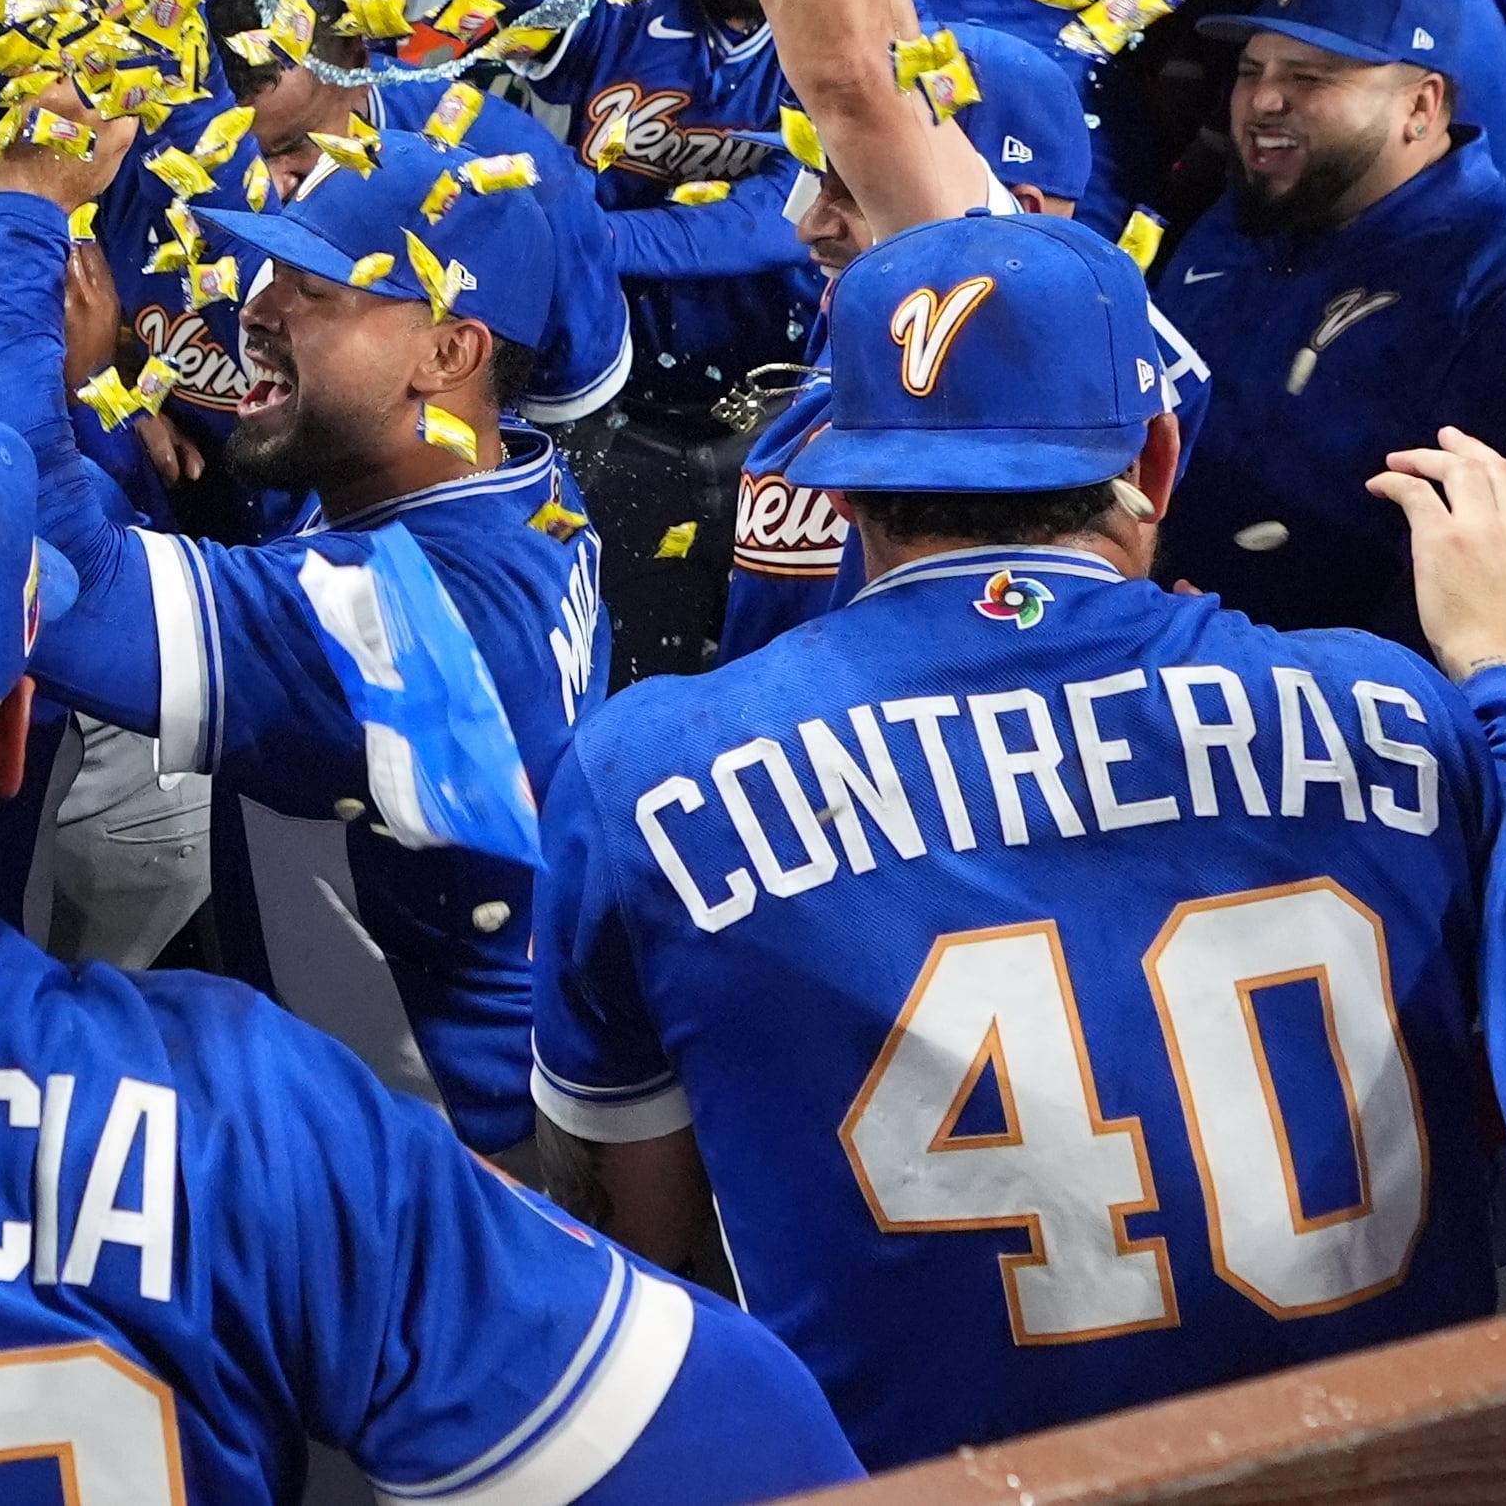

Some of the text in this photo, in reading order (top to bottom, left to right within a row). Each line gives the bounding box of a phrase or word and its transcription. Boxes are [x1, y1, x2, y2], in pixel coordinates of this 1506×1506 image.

[889, 275, 997, 398] V
[633, 662, 1441, 934] CONTRERAS
[837, 874, 1431, 1348] 40
